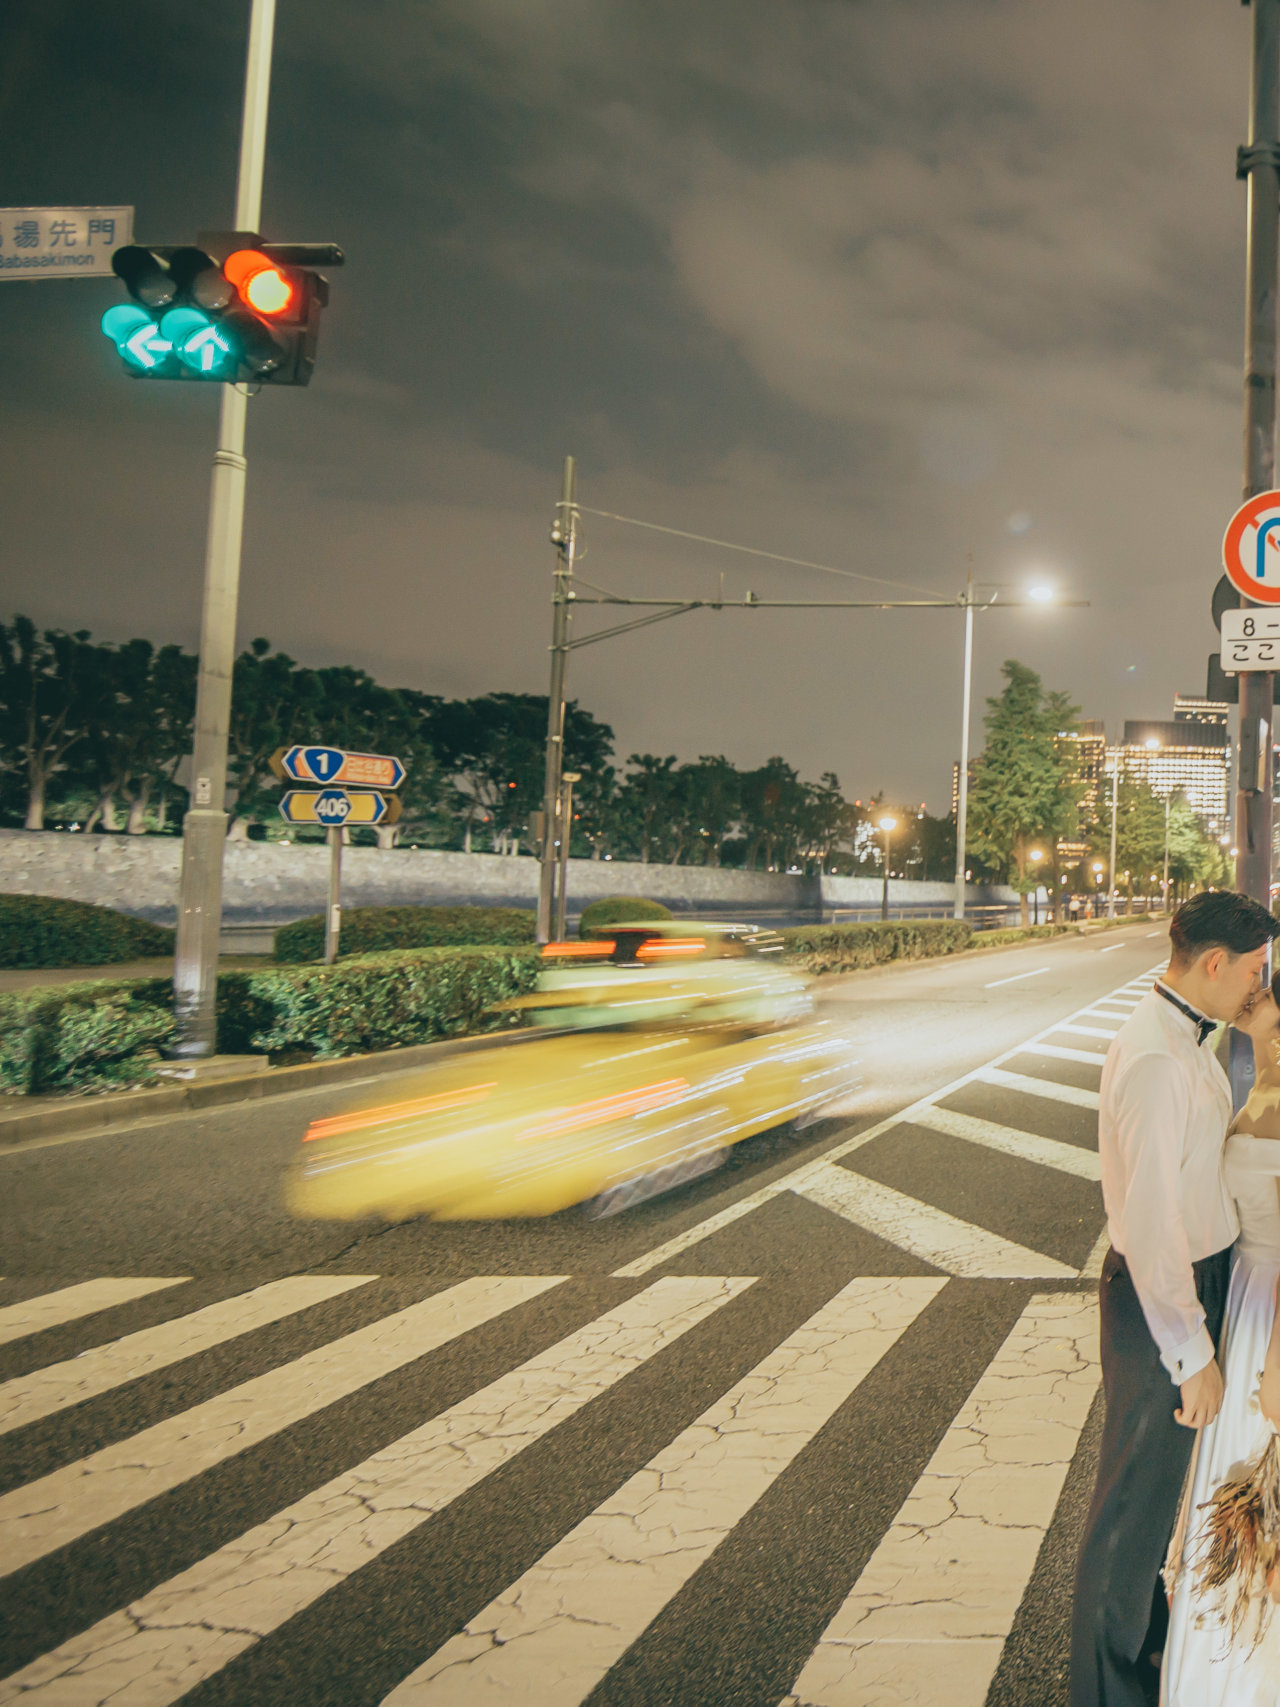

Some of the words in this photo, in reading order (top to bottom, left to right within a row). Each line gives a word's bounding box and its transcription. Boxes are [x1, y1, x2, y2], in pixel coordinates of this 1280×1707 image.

[0, 219, 115, 248] 場先門
[316, 753, 329, 774] 1
[316, 797, 349, 817] 406
